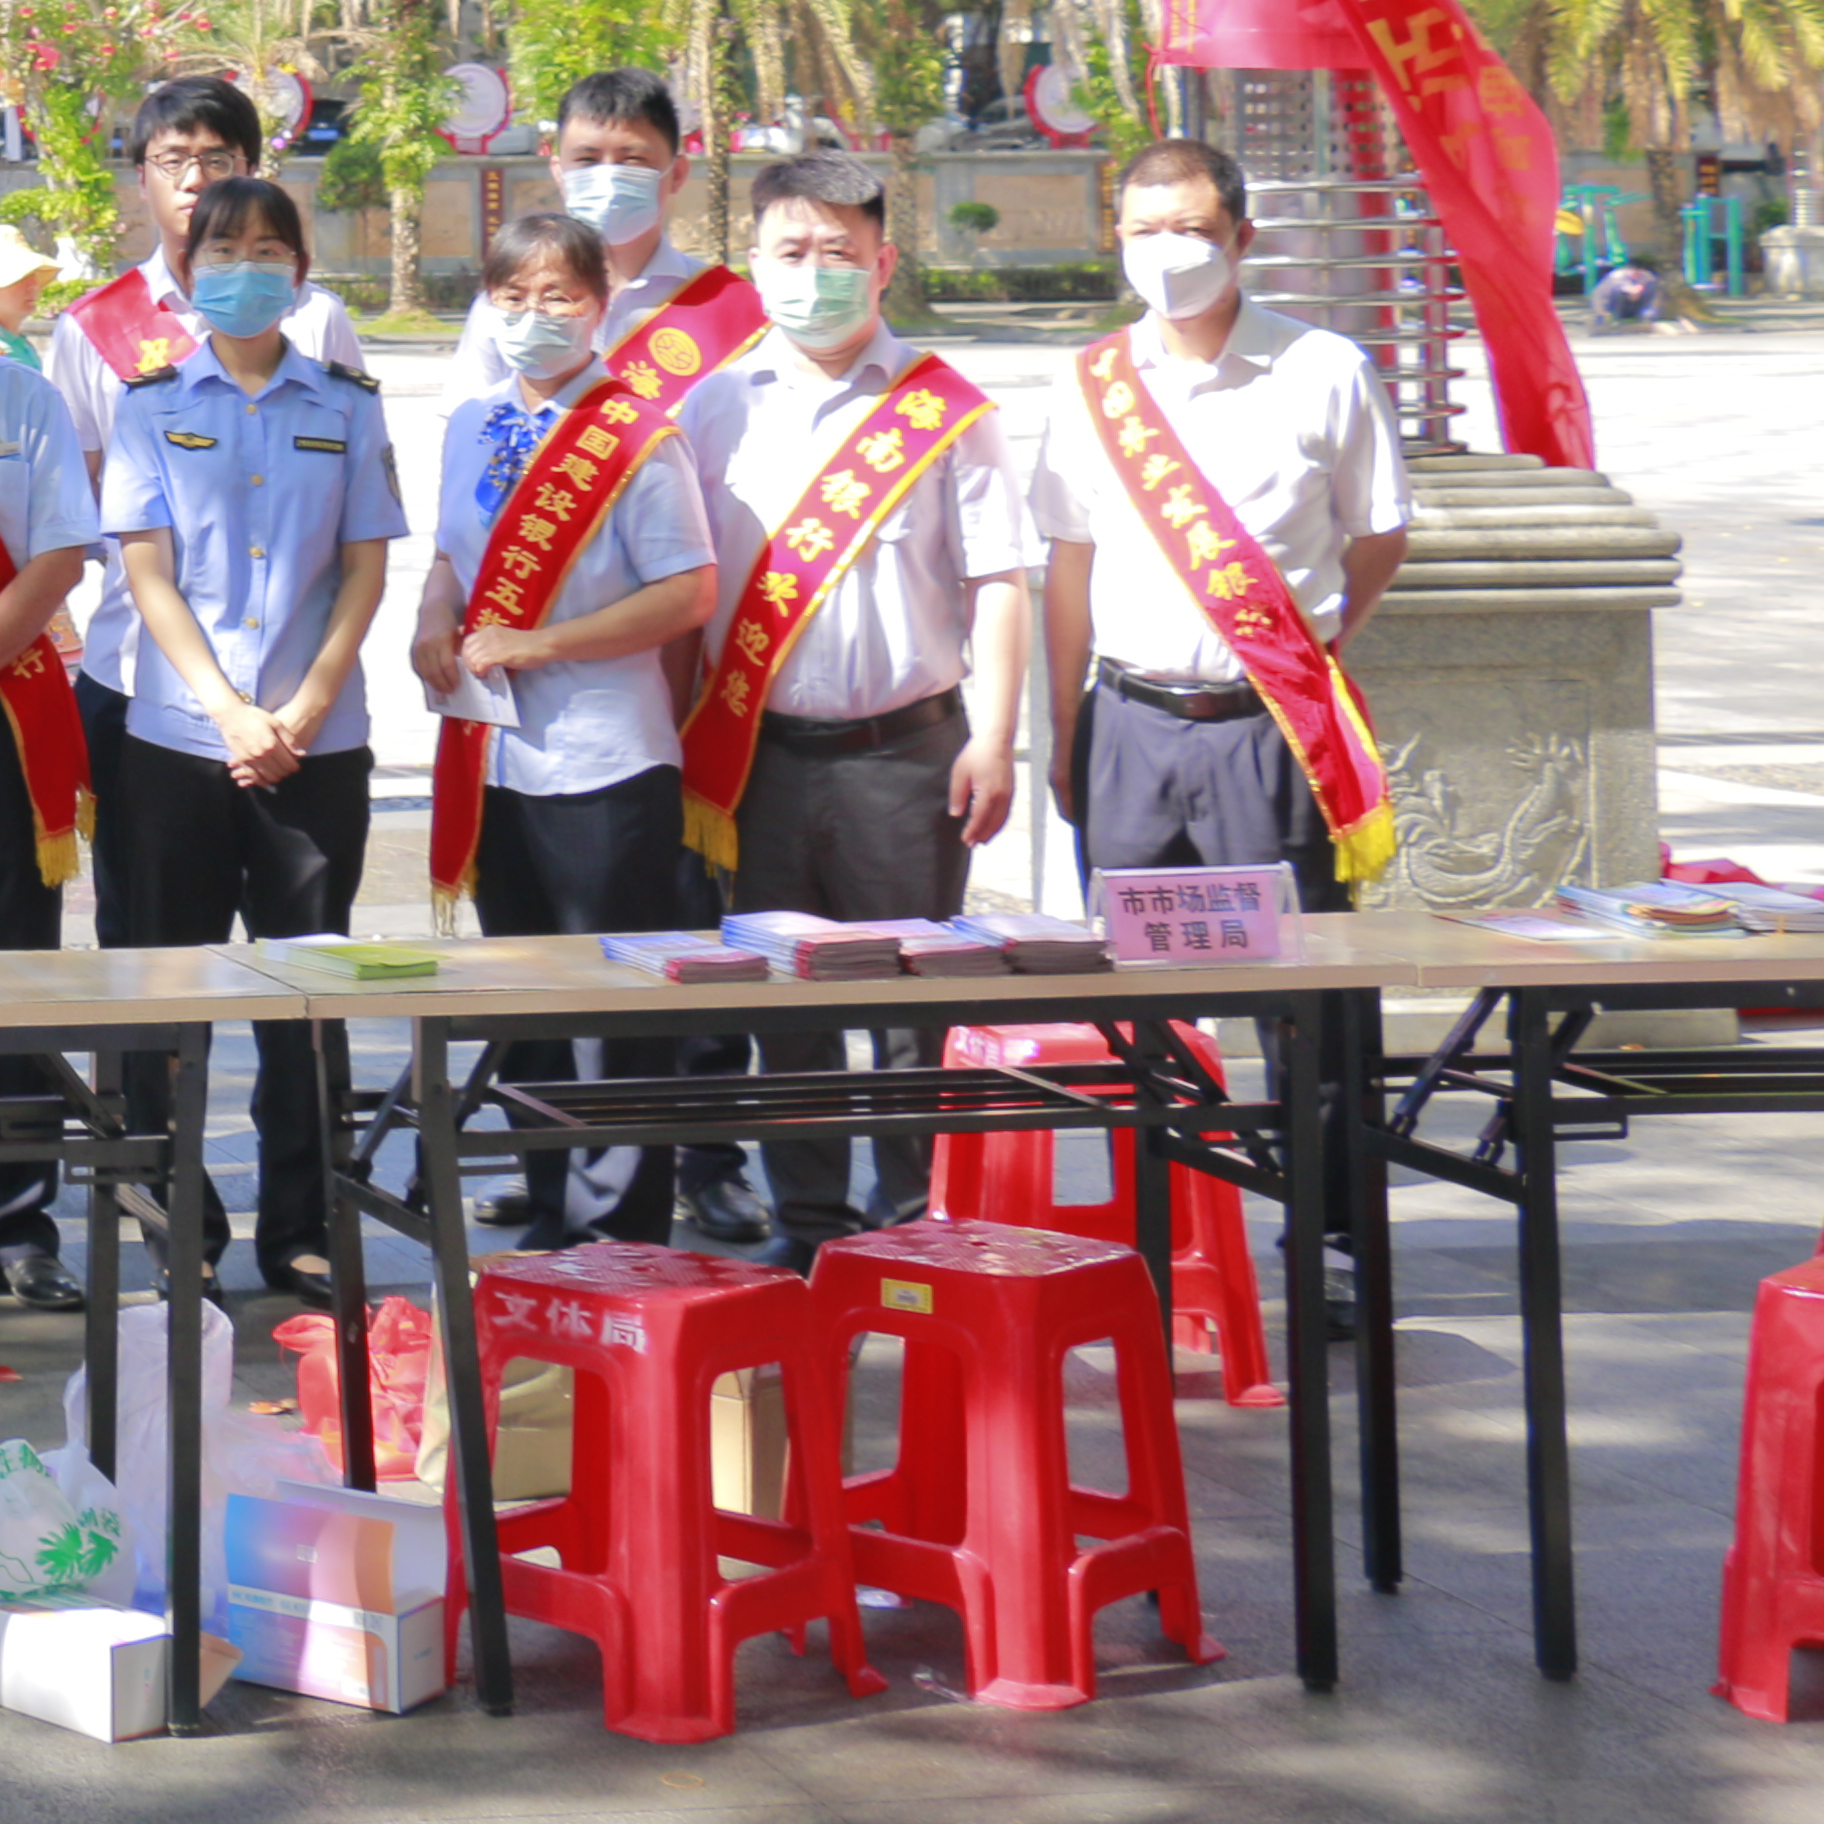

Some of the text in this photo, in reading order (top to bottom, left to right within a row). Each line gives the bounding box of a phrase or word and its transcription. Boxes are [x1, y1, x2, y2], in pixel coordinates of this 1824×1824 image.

[1118, 882, 1262, 915] 市市场监督
[1144, 919, 1249, 953] 管理局
[492, 1291, 647, 1353] 文体局
